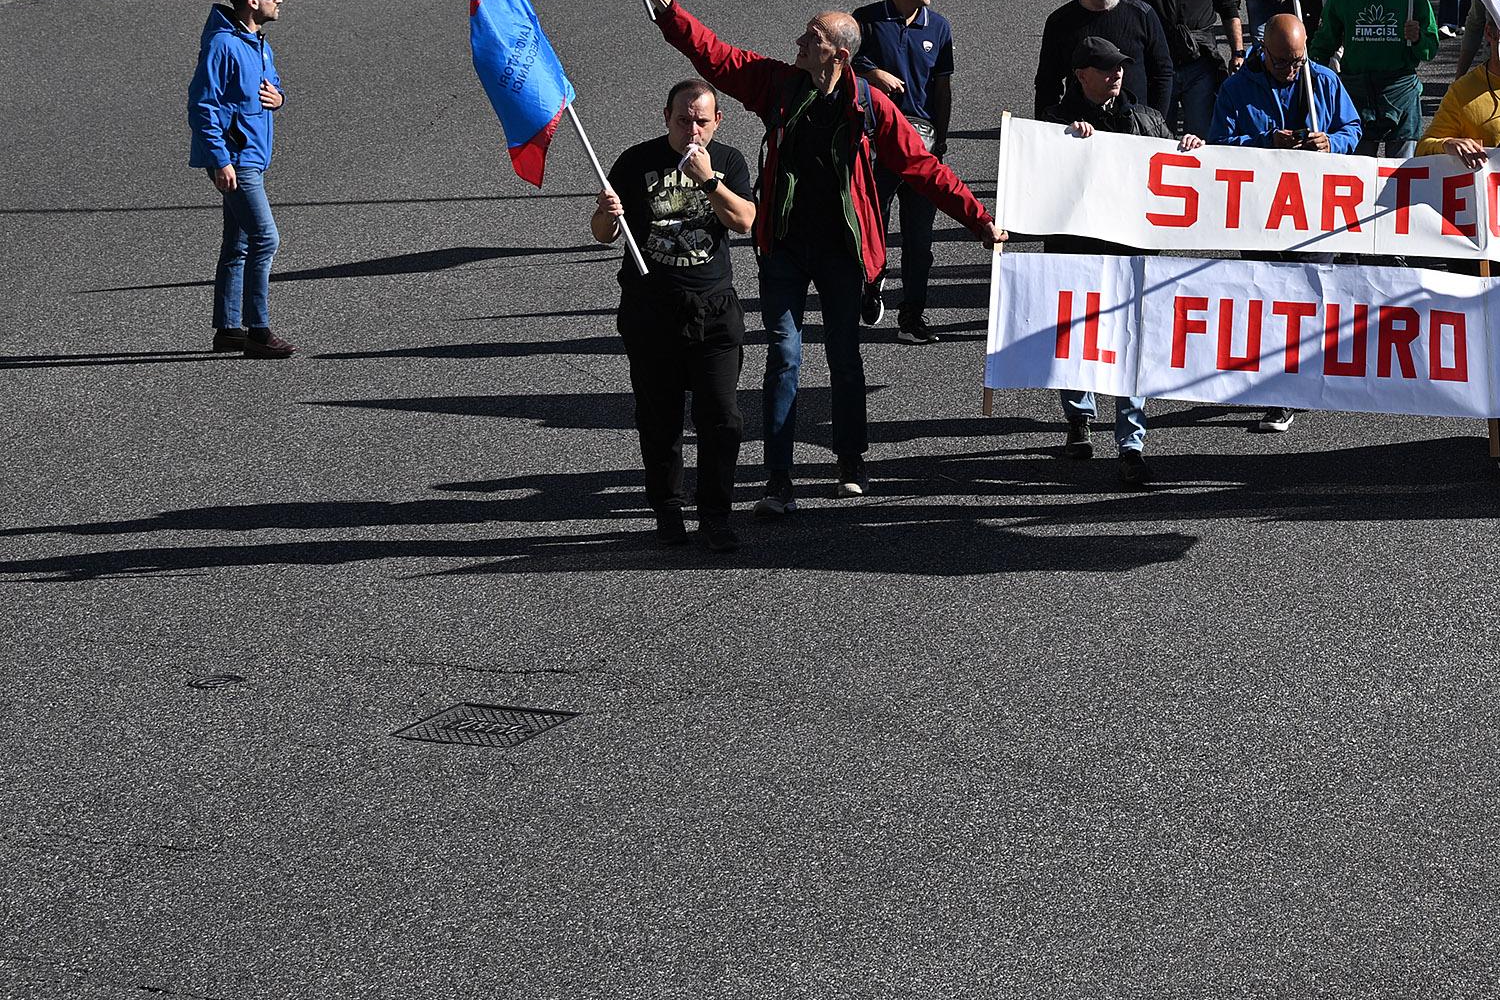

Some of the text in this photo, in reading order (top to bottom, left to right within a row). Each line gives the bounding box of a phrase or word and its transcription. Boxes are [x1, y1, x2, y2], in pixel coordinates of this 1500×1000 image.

[1355, 26, 1399, 36] FIM-CISL
[1055, 290, 1117, 365] IL
[1170, 295, 1469, 383] FUTURO
